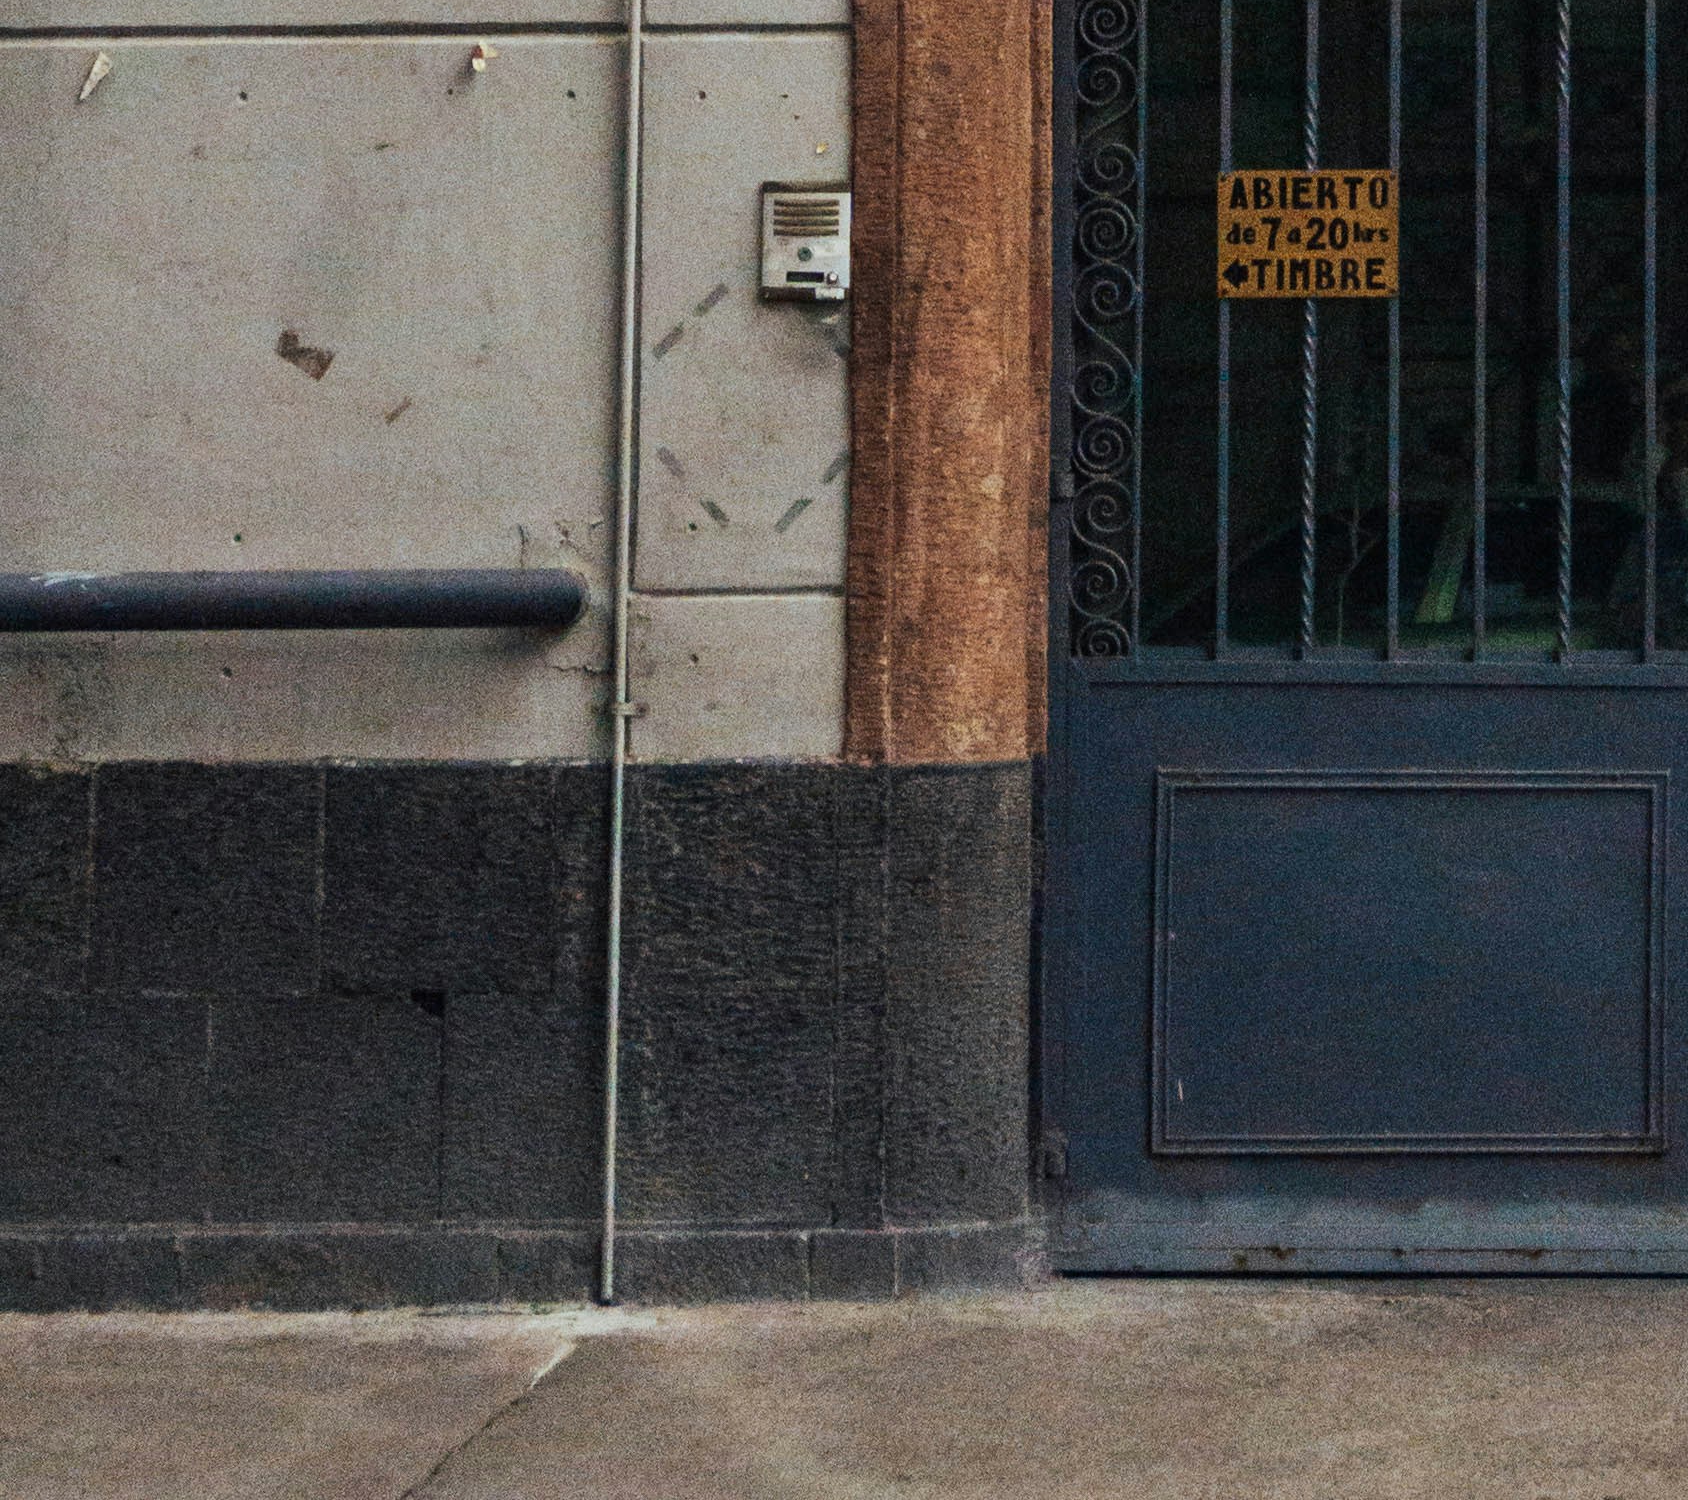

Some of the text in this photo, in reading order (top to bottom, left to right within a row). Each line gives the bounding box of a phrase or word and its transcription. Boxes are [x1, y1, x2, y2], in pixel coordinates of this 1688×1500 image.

[1229, 177, 1389, 210] ABIERTO
[1226, 217, 1390, 250] de 7 a 20 hrs
[1251, 258, 1386, 290] TIMBRE
